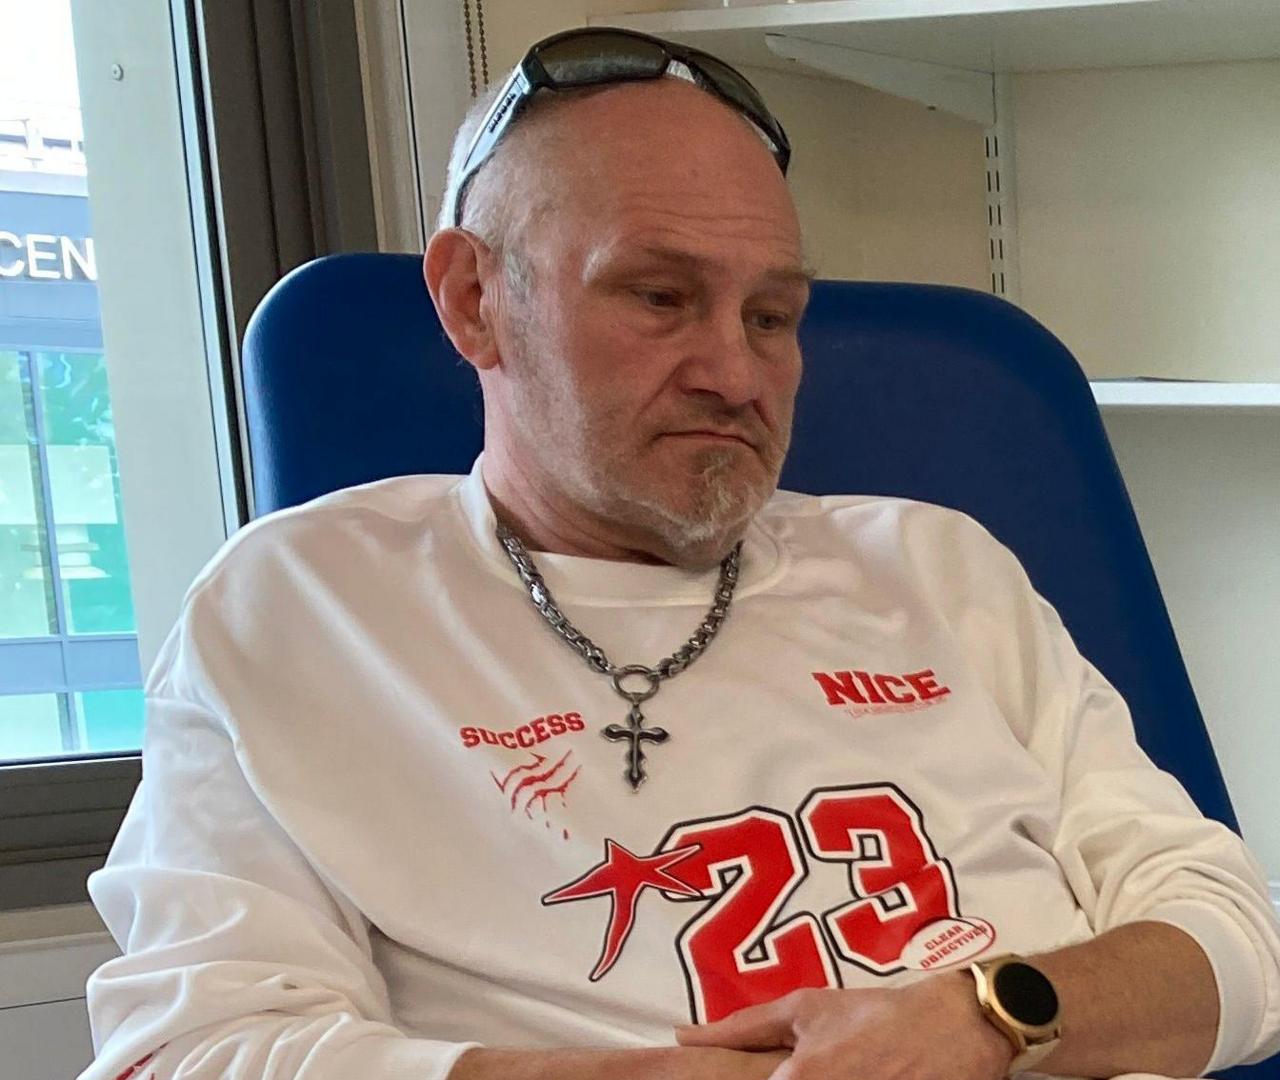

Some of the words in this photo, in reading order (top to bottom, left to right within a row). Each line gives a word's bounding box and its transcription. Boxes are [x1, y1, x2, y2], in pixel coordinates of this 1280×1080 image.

[811, 669, 951, 705] NICE
[460, 711, 585, 749] SUCCESS
[655, 782, 962, 1025] 23
[924, 924, 965, 950] CLEAN
